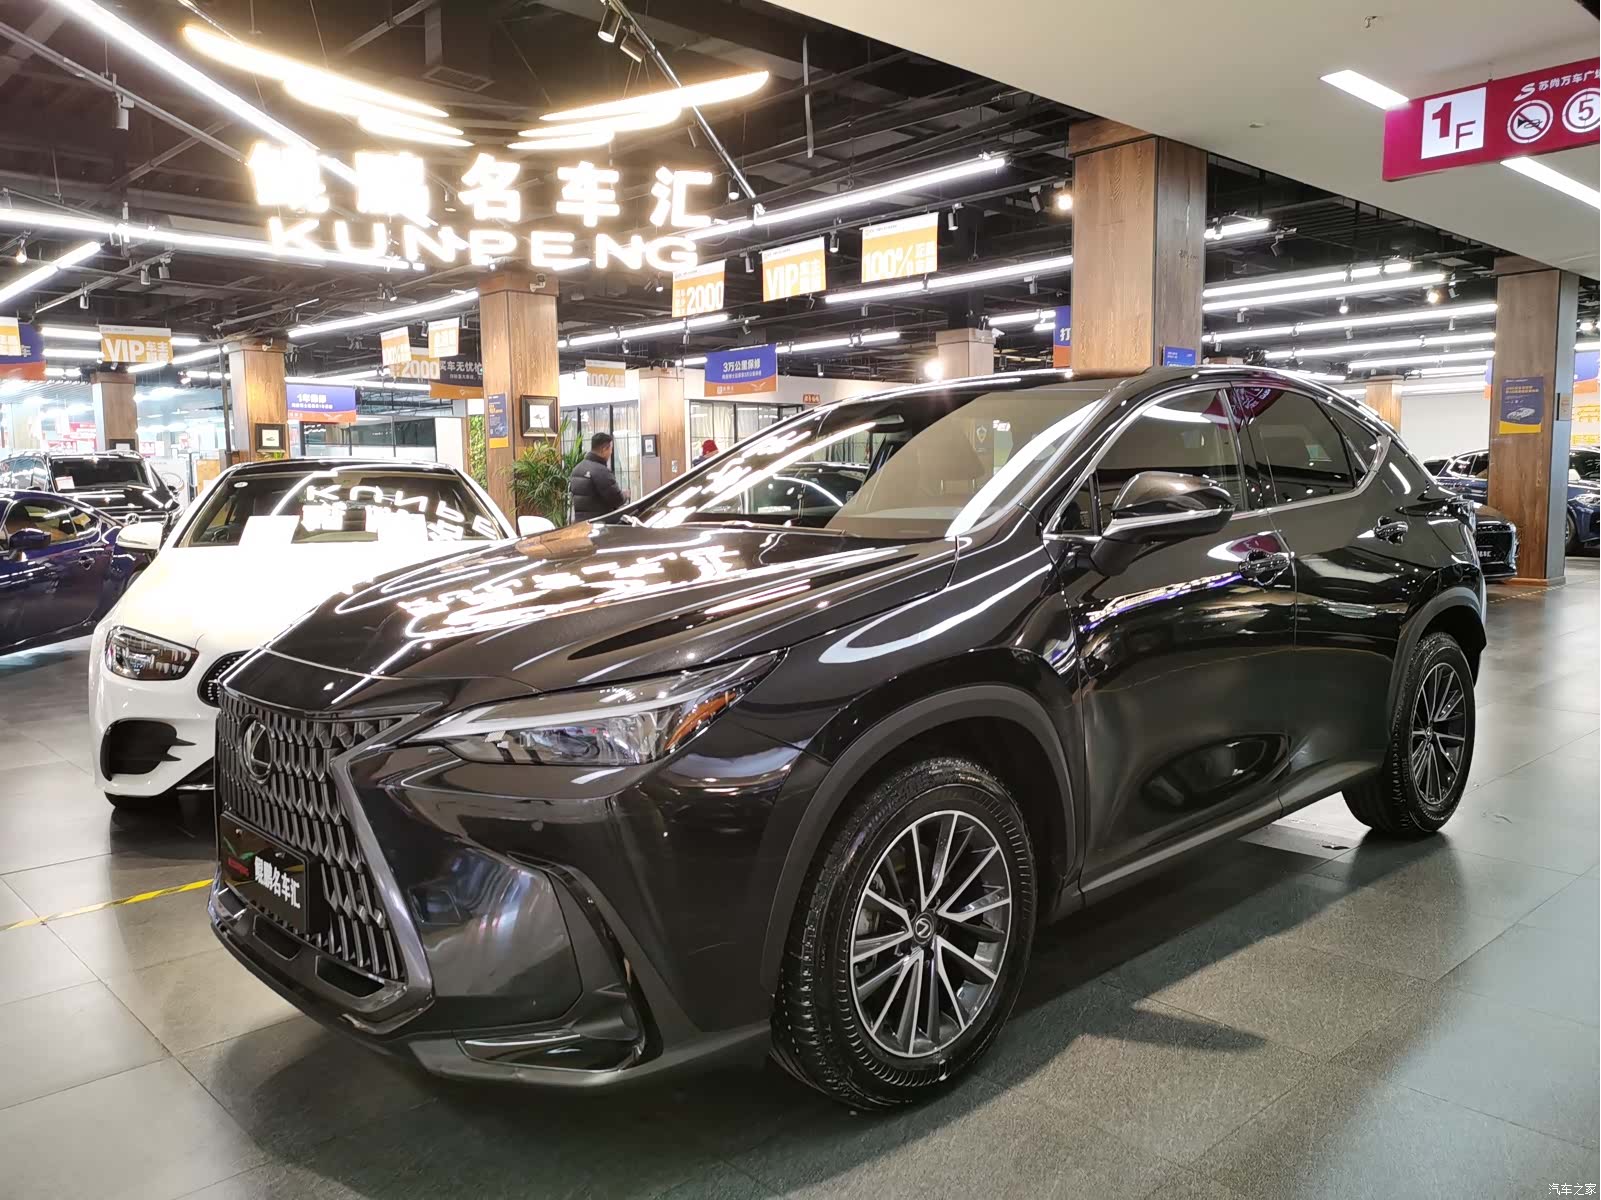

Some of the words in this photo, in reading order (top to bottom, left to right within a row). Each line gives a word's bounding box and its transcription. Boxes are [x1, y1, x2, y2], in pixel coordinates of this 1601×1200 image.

[1578, 98, 1594, 121] 5
[248, 142, 713, 227] 名车汇
[269, 217, 698, 272] KUNPENG
[686, 281, 724, 315] 2000
[766, 263, 799, 300] VIP
[104, 338, 145, 363] VIP
